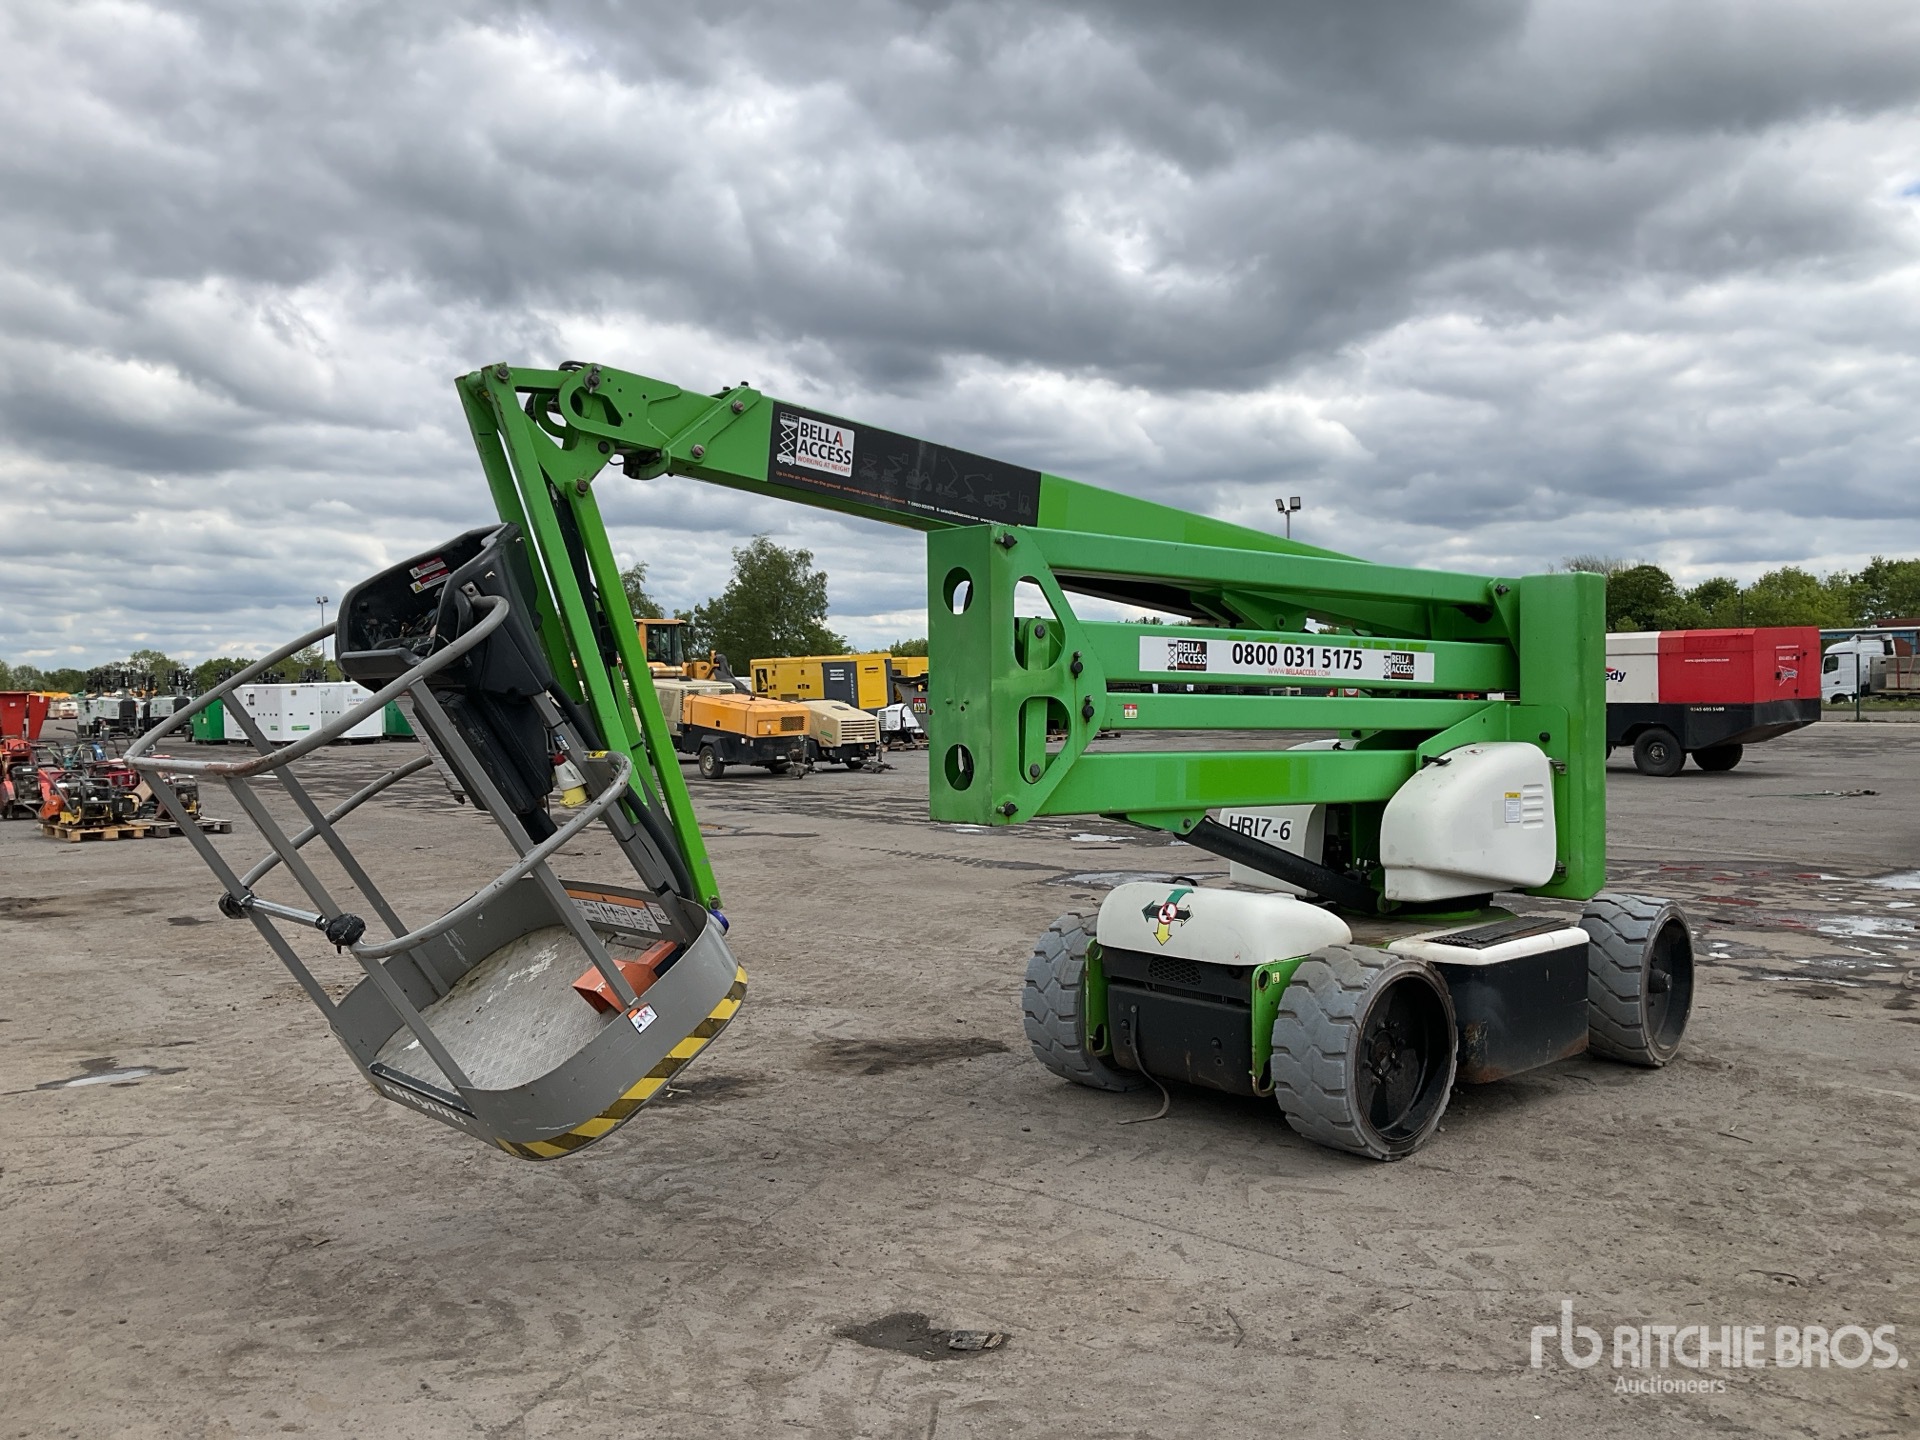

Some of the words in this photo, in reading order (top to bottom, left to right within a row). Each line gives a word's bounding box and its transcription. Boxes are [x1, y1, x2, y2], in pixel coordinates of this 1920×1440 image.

[800, 422, 843, 447] BELLA
[798, 439, 851, 465] ACCESS
[798, 455, 821, 467] WORKING
[831, 464, 850, 473] HEIGHT
[1178, 642, 1201, 653] BELLA
[1178, 653, 1206, 664] ACCESS
[1232, 643, 1278, 666] 0800
[1284, 646, 1314, 667] 031
[1322, 649, 1362, 670] 5175
[1391, 654, 1410, 664] BELLA
[1391, 664, 1414, 674] ACCESS
